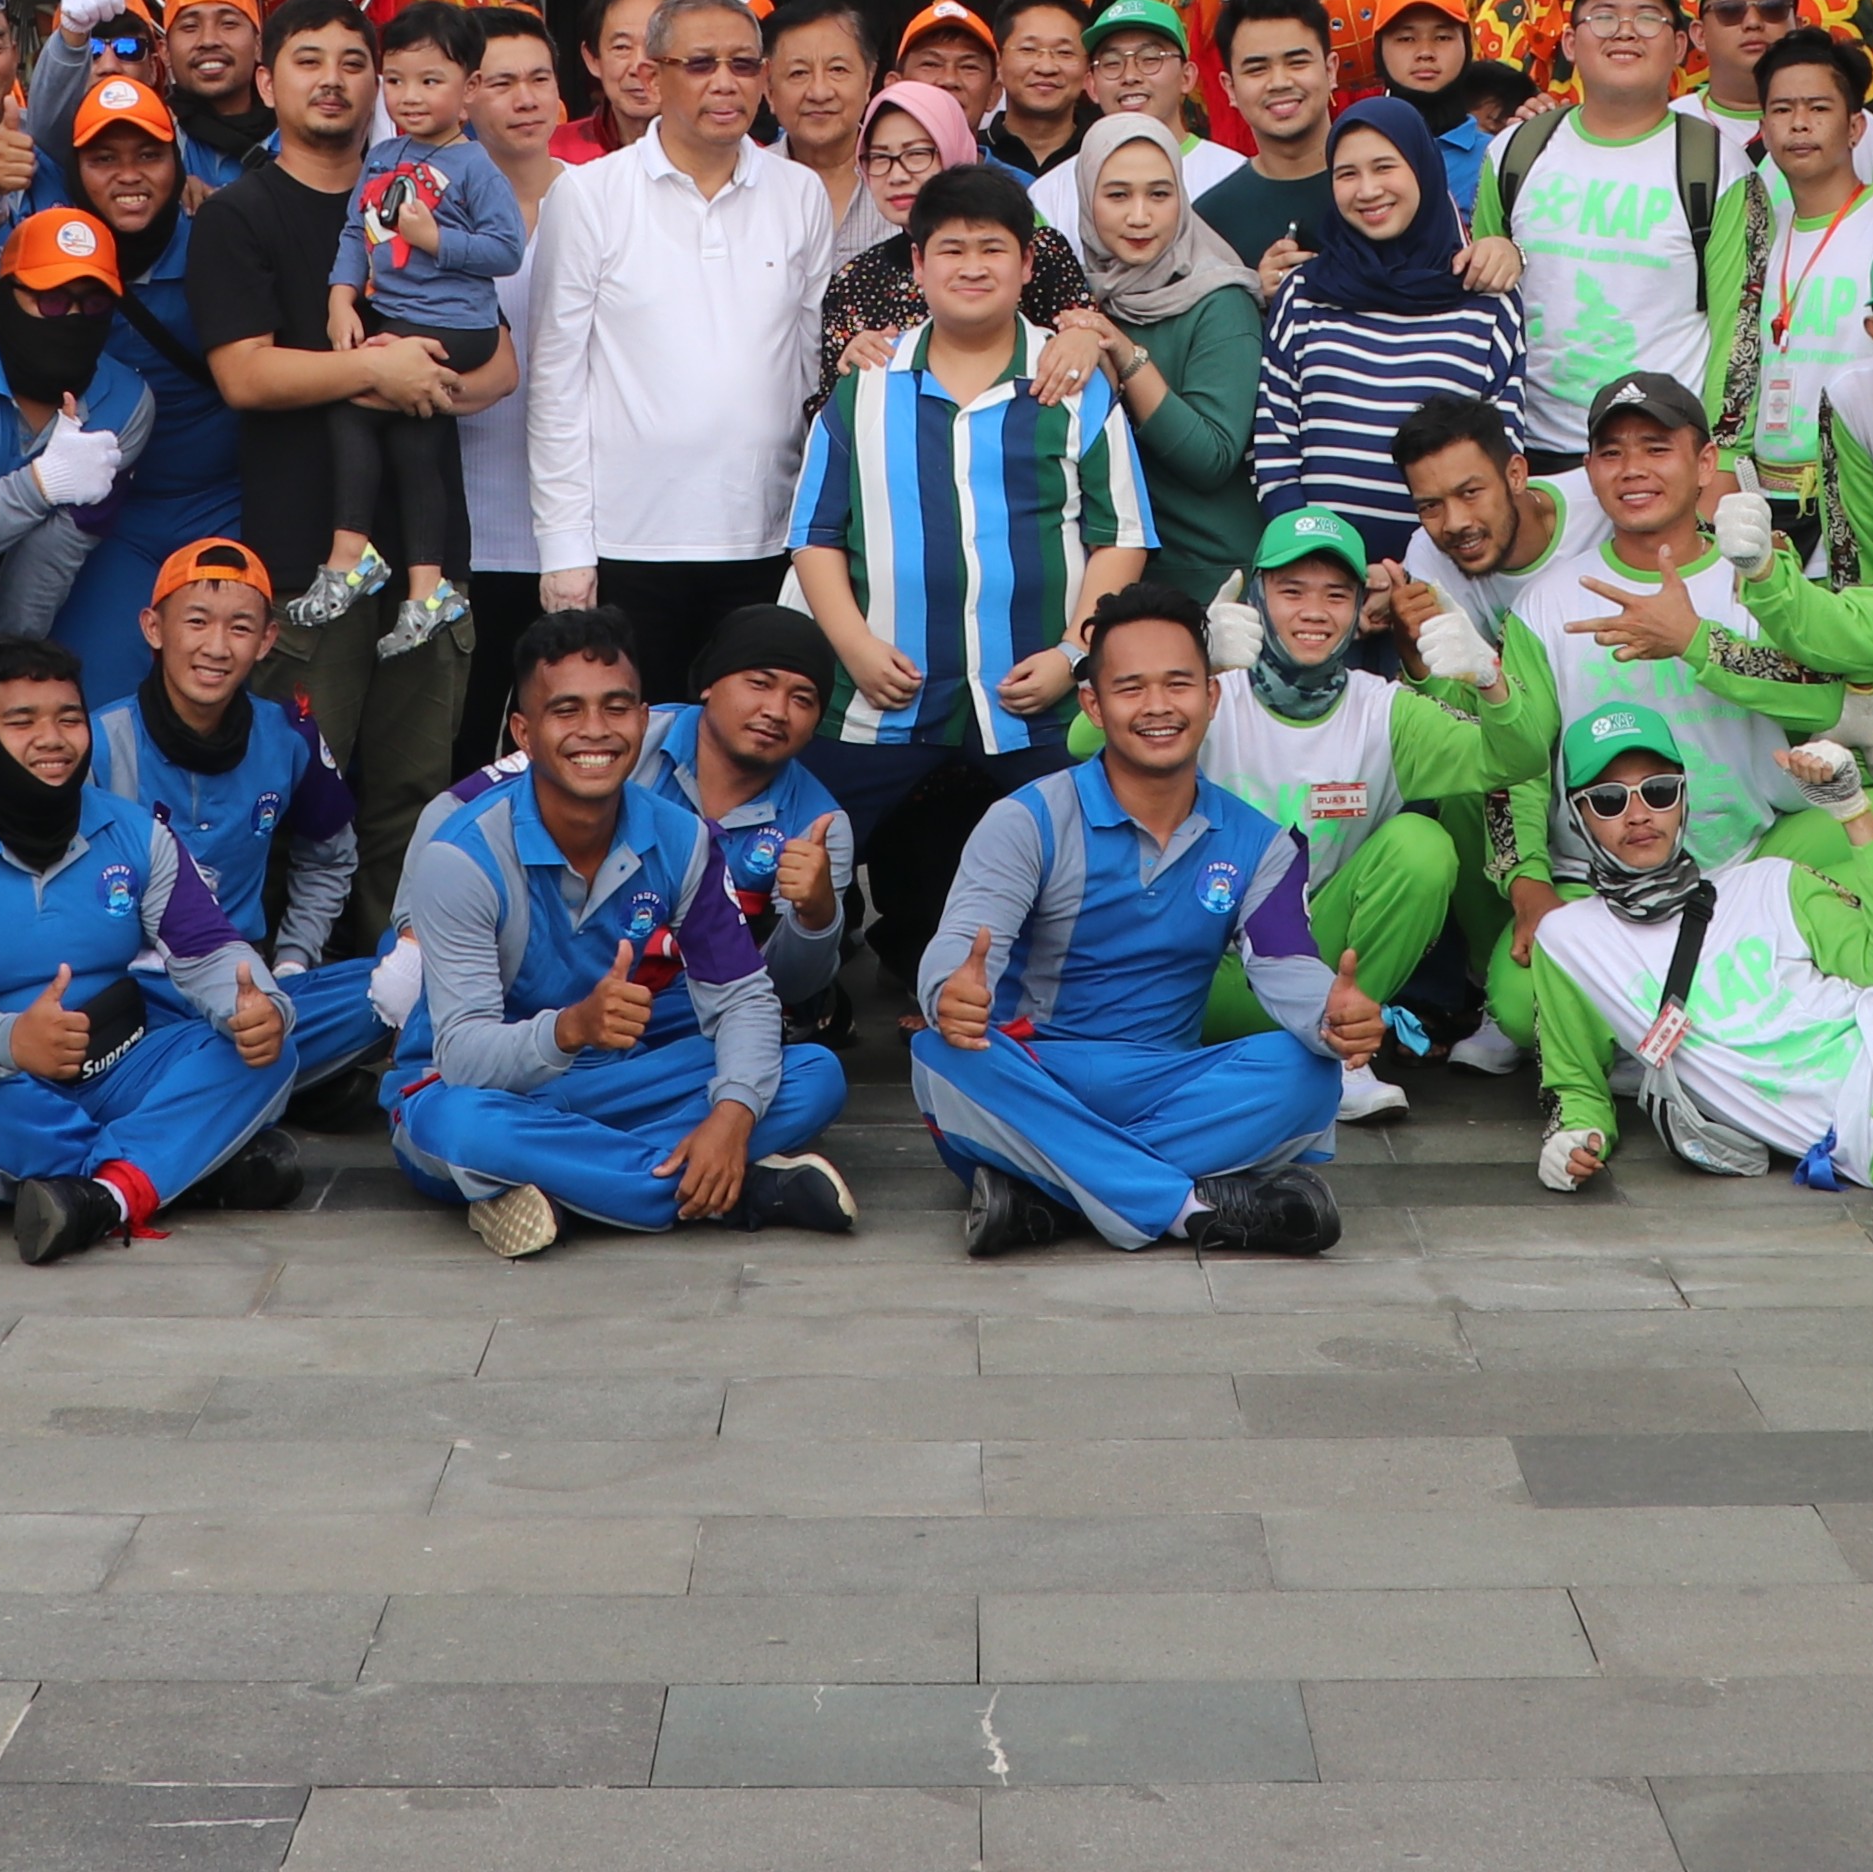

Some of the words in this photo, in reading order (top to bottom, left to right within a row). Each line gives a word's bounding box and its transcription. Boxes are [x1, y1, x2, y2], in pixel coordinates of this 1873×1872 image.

[1578, 178, 1673, 241] KAP
[1314, 516, 1341, 533] KAP
[1609, 712, 1636, 729] KAP
[1317, 796, 1346, 805] RUAS
